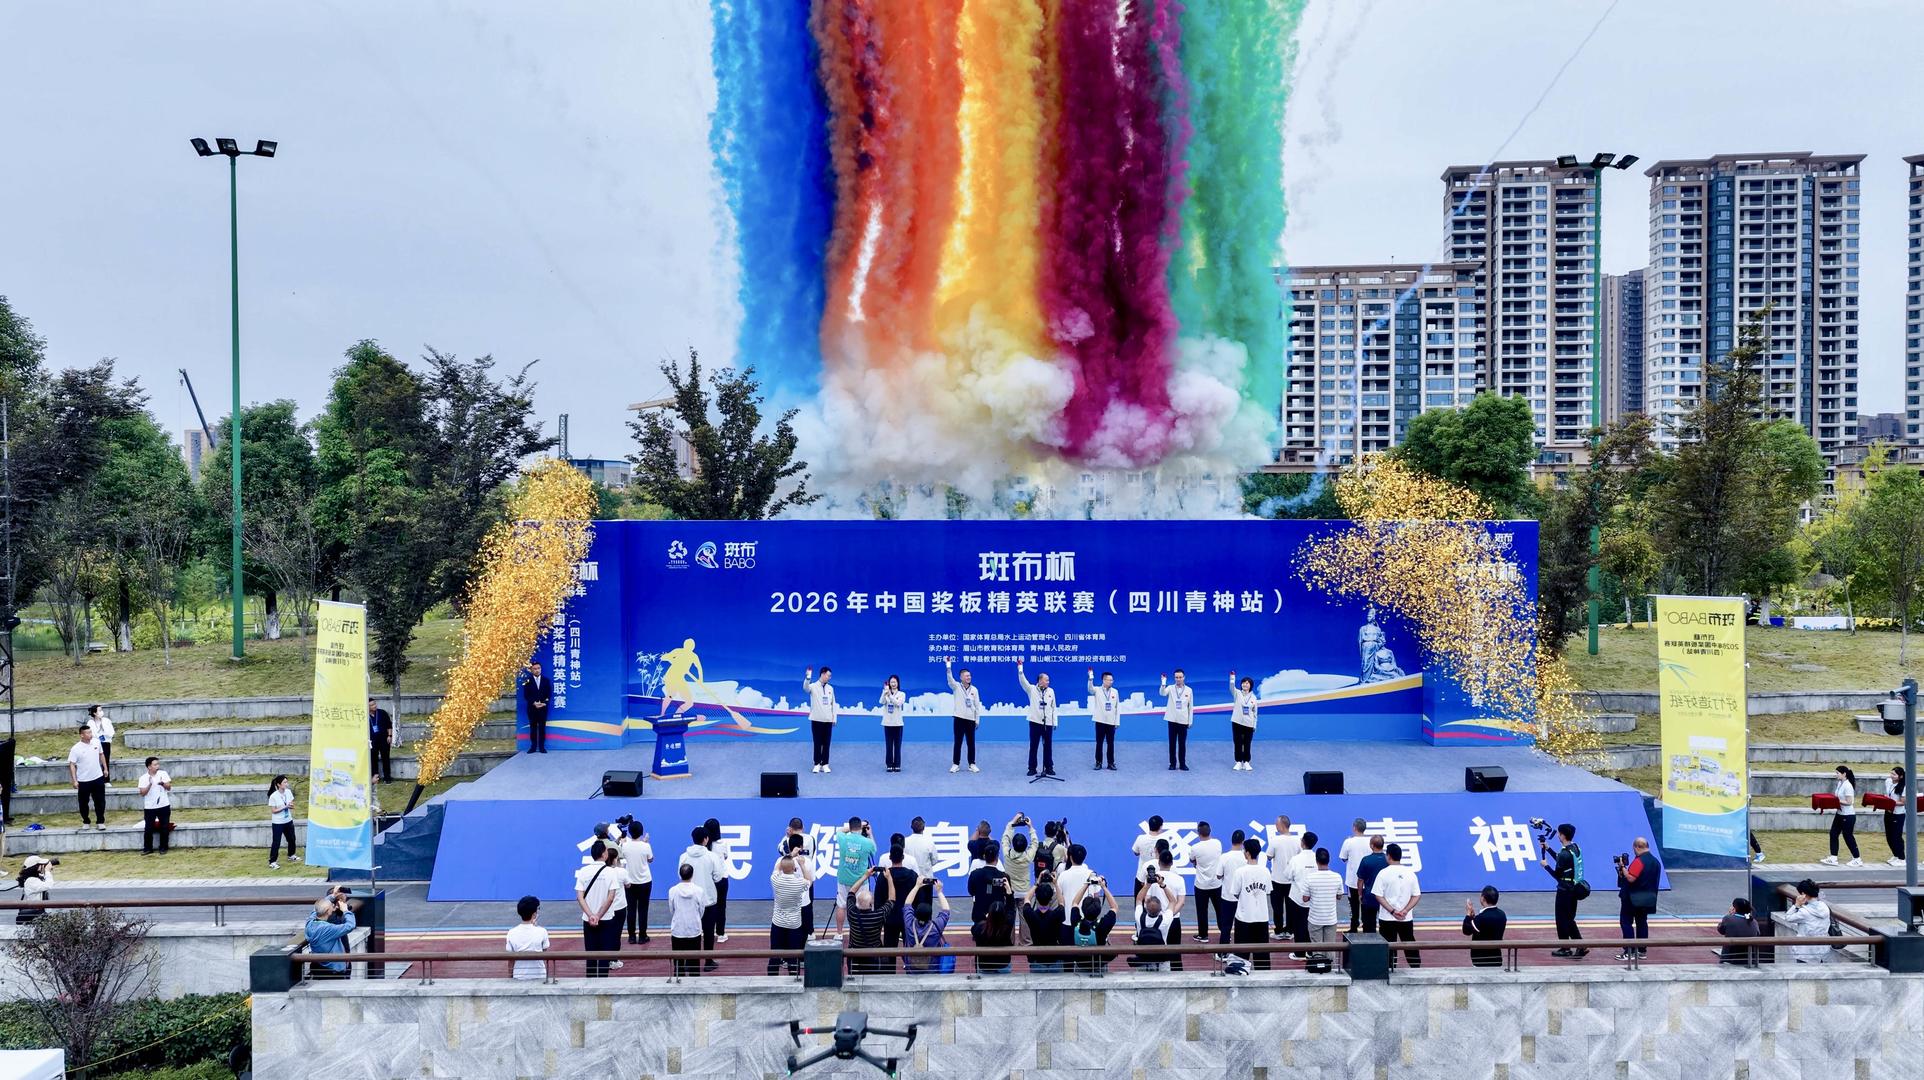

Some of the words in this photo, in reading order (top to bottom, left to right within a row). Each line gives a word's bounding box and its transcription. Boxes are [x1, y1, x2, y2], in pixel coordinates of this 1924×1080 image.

[724, 542, 756, 557] 斑布
[724, 558, 755, 568] BABO
[978, 551, 1076, 581] 斑布杯
[1064, 633, 1106, 641] 四川省体育局
[1030, 644, 1079, 652] 青神县人民政府
